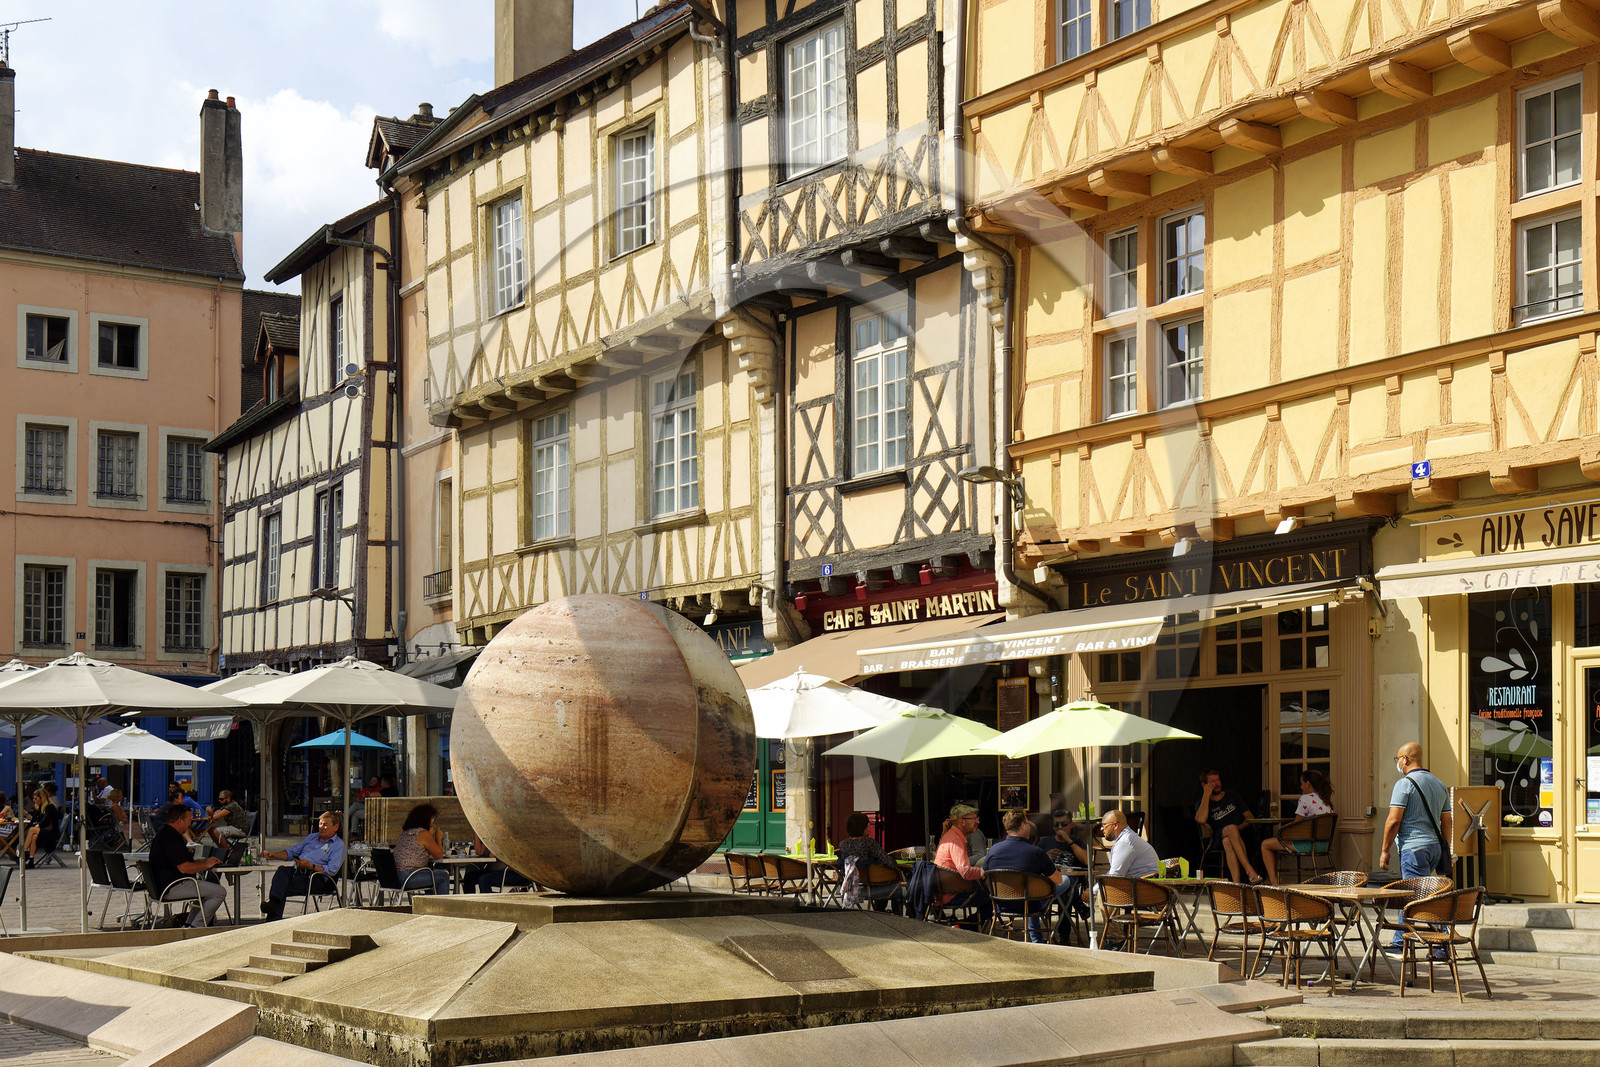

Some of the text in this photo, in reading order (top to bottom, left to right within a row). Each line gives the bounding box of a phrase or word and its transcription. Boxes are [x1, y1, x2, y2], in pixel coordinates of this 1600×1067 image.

[1414, 463, 1427, 477] 4
[1480, 513, 1526, 555] AUX
[1082, 548, 1347, 607] Le SAINT VINCENT
[1483, 565, 1540, 590] CAFÉ
[823, 589, 997, 632] CAFE SAINT MARTIN
[714, 624, 752, 652] ANT
[929, 635, 1064, 658] BAR LE ST VINCENT
[863, 635, 1156, 674] BAR BRASSERIE SALADERIE BAR à VINS
[1488, 685, 1537, 707] RESTAURANT
[1478, 708, 1492, 719] Cuisine
[1493, 707, 1522, 719] traditionnelle
